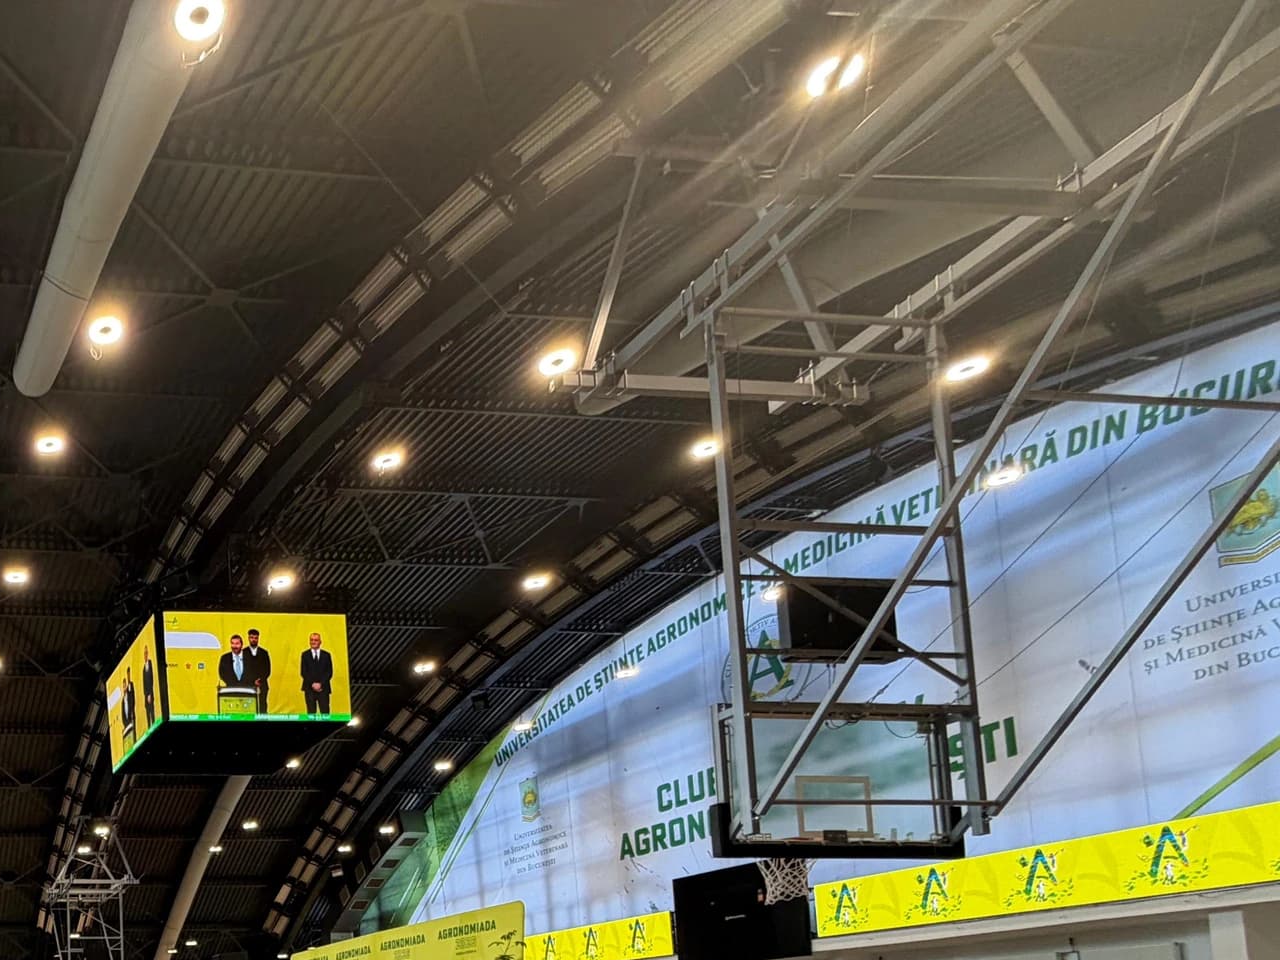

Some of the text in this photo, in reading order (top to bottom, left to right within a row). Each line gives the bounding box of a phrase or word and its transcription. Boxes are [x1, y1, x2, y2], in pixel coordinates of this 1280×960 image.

[494, 695, 576, 768] UNIVERSITATEA
[576, 680, 593, 703] DE
[1066, 410, 1128, 459] DIN
[1136, 359, 1280, 435] BUCUR
[1166, 625, 1267, 666] MEDICINĂ
[1193, 661, 1230, 681] DIN
[619, 809, 713, 861] AGRON
[380, 934, 426, 951] AGRONOMIADA
[438, 920, 496, 940] AGRONOMIADA
